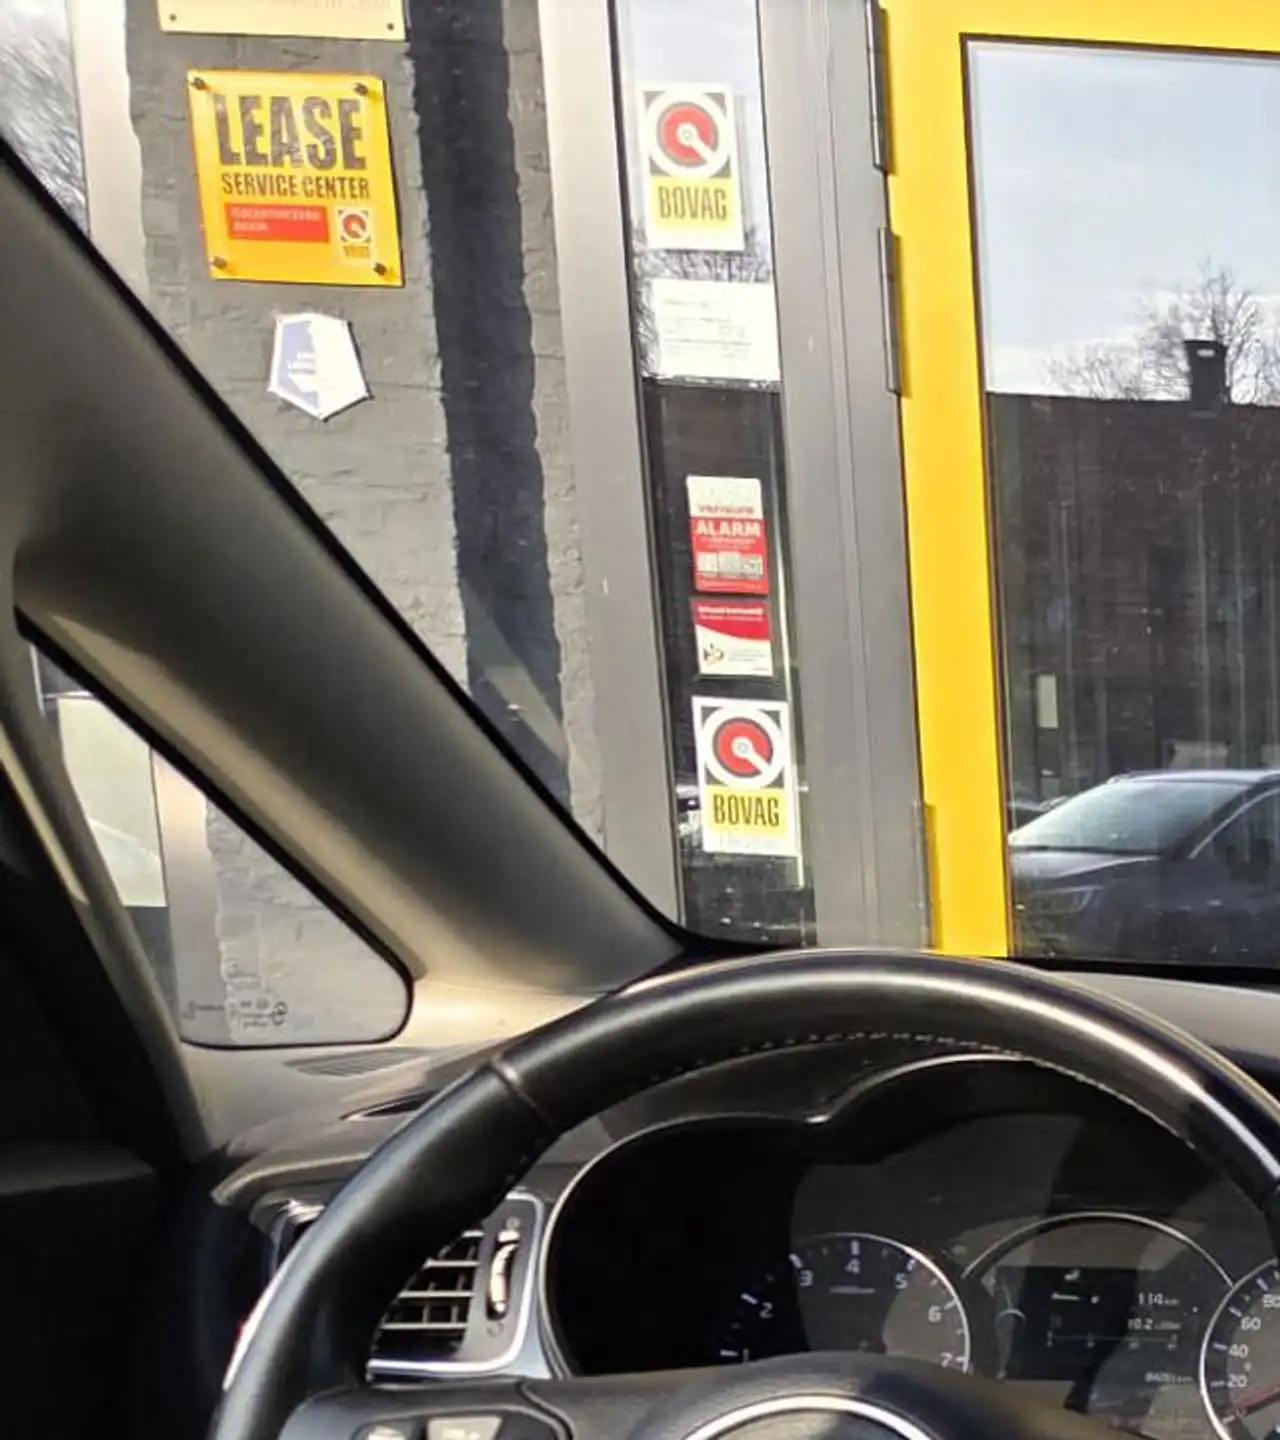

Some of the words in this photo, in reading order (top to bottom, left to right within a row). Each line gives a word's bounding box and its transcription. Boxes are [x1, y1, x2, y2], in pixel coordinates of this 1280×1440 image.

[213, 93, 367, 170] LEASE
[221, 171, 300, 197] SERVICE
[301, 175, 370, 200] CENTER
[657, 184, 728, 221] BOVAG
[696, 519, 761, 538] ALARM
[713, 793, 780, 828] BOVAG
[800, 1270, 814, 1286] 3
[895, 1272, 908, 1289] 5
[759, 1301, 774, 1319] 2
[928, 1305, 942, 1323] 6
[1240, 1316, 1262, 1331] 60
[1229, 1344, 1250, 1359] 40
[1227, 1375, 1248, 1389] 20
